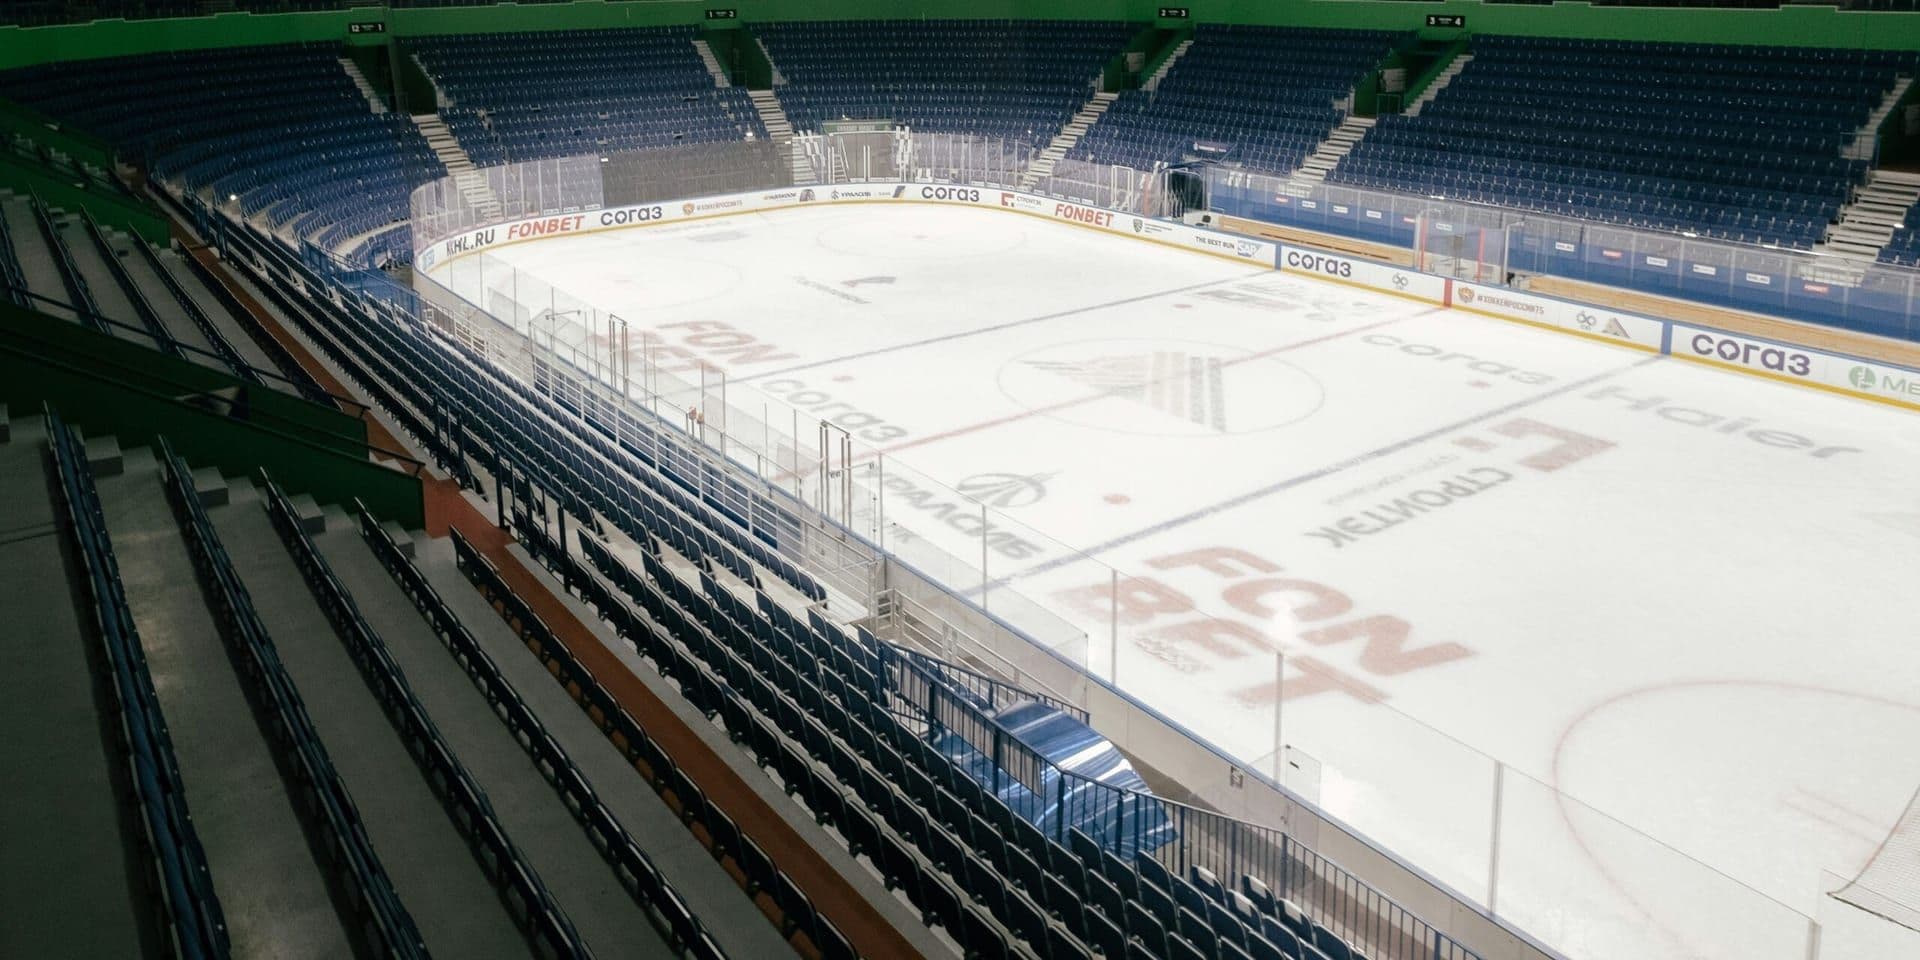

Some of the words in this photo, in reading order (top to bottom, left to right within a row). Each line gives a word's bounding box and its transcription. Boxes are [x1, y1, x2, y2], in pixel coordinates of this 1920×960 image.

[508, 215, 586, 240] FONBET
[1054, 203, 1115, 228] FONBET
[446, 228, 497, 257] KHL.RU
[1195, 235, 1207, 245] THE
[1207, 237, 1222, 248] BEST
[1222, 239, 1236, 250] RUN
[1142, 545, 1480, 677] FON
[1052, 575, 1394, 706] BET
